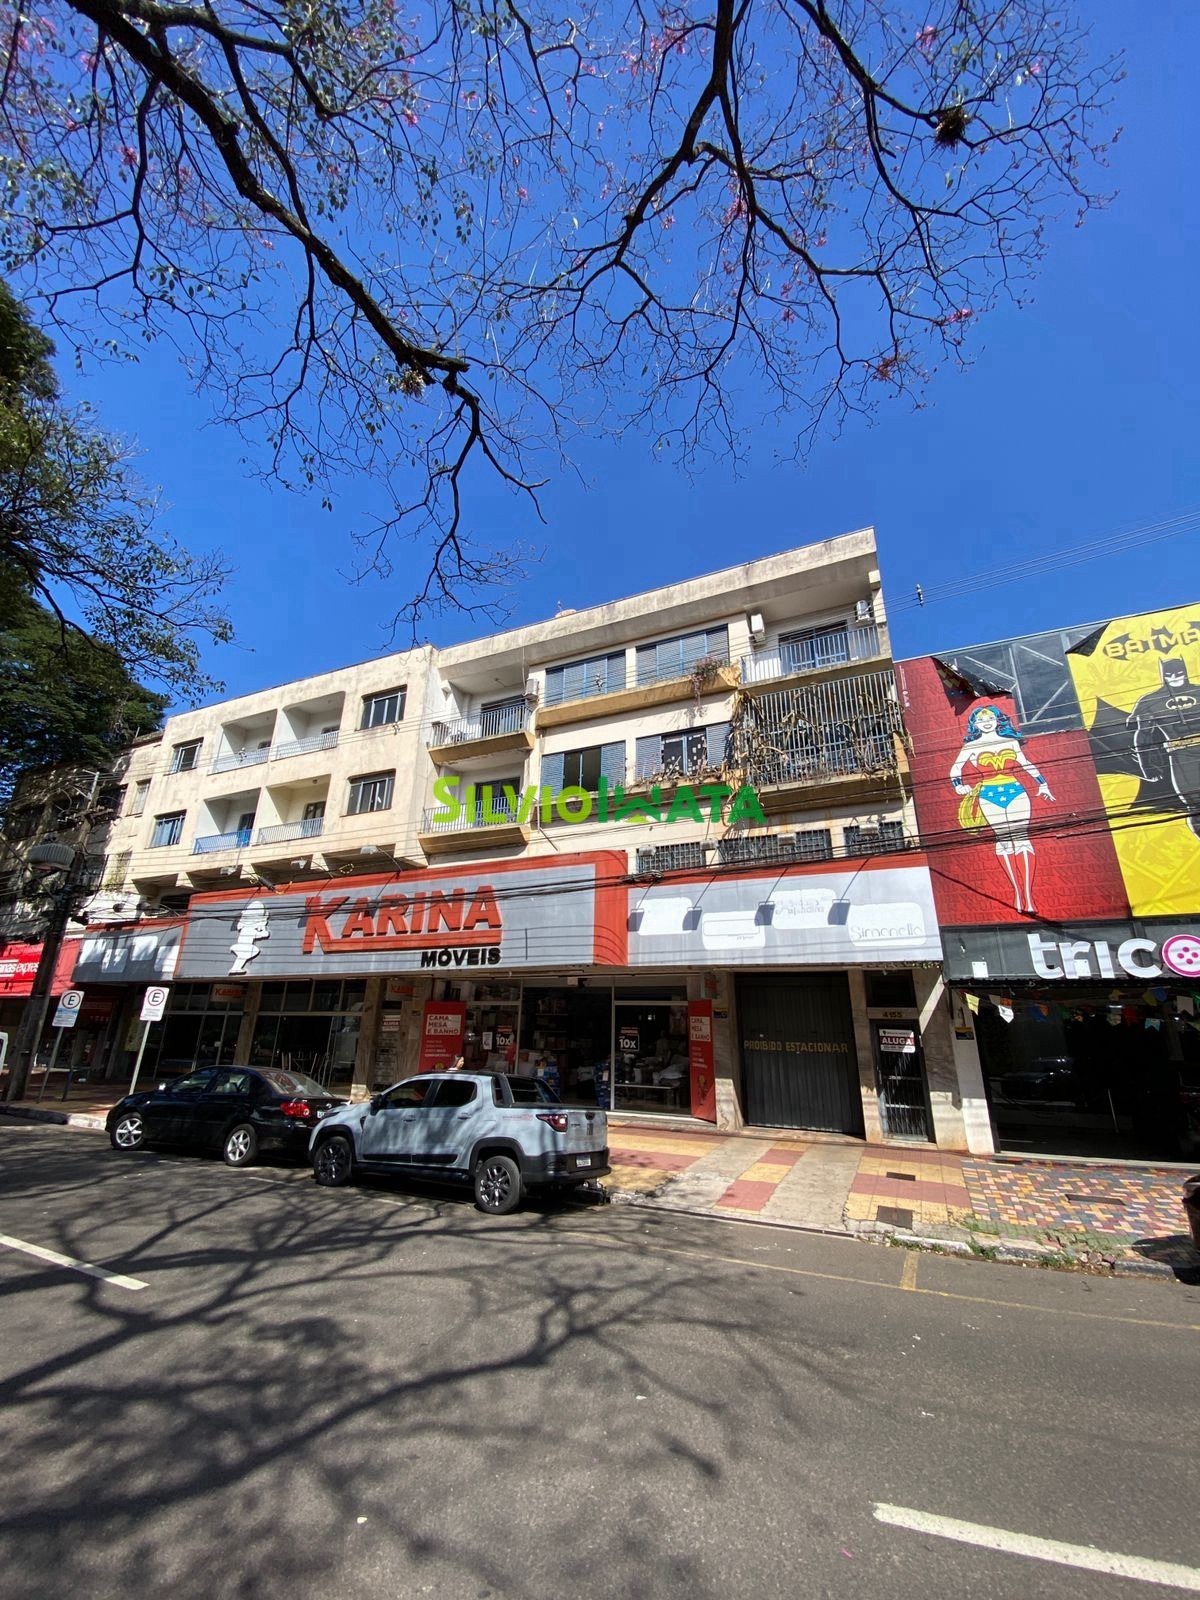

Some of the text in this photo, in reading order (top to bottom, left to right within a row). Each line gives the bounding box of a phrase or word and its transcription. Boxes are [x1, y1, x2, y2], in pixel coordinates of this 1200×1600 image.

[303, 885, 503, 954] KARINA
[421, 947, 501, 968] MÓVEIS
[619, 1039, 636, 1049] 10x
